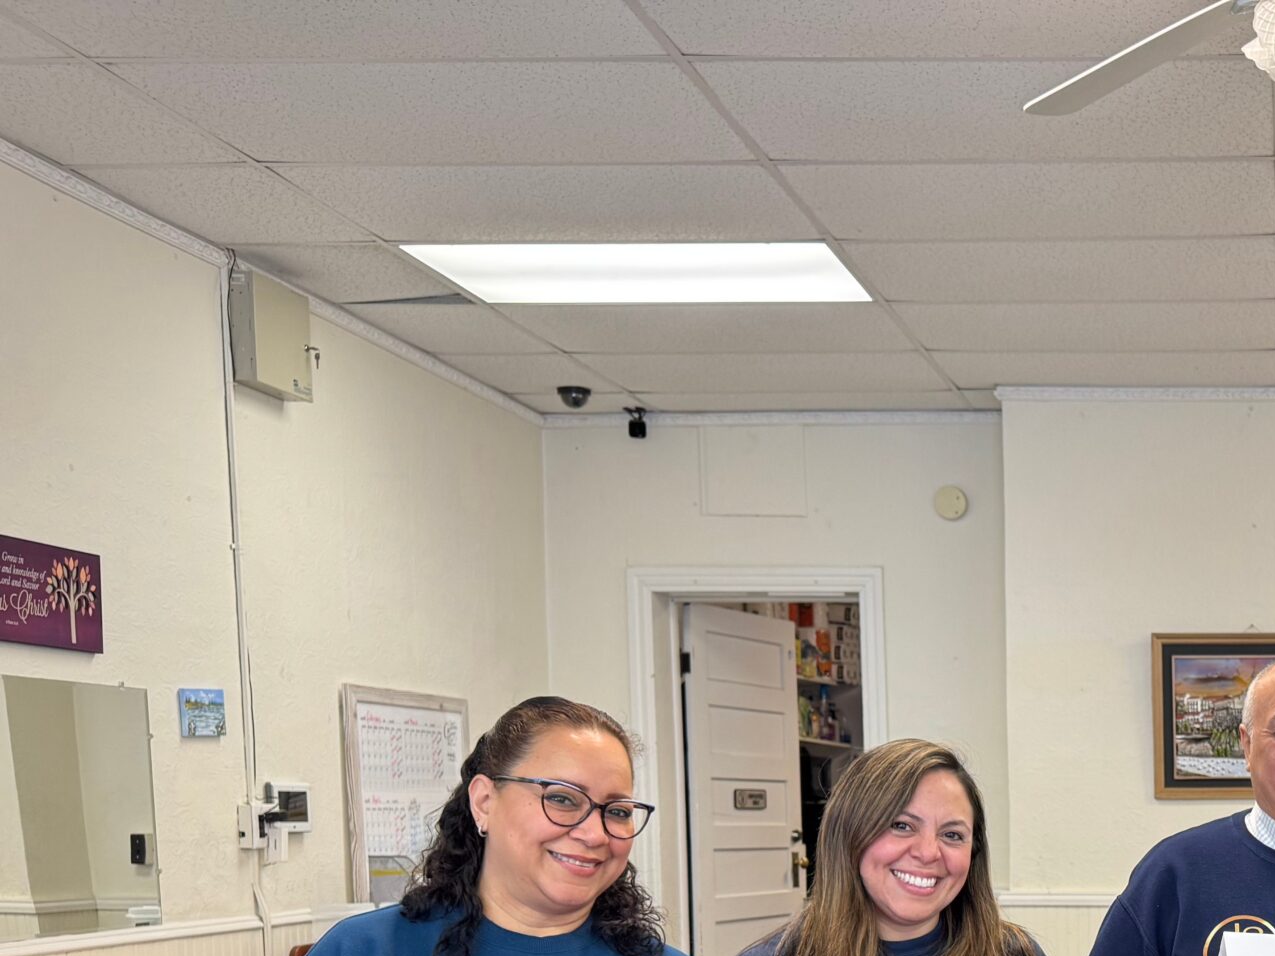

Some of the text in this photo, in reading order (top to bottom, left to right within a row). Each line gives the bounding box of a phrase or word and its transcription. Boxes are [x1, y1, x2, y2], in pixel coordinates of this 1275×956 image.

[13, 564, 39, 582] knowledge
[39, 570, 47, 583] of
[9, 589, 50, 625] Christ
